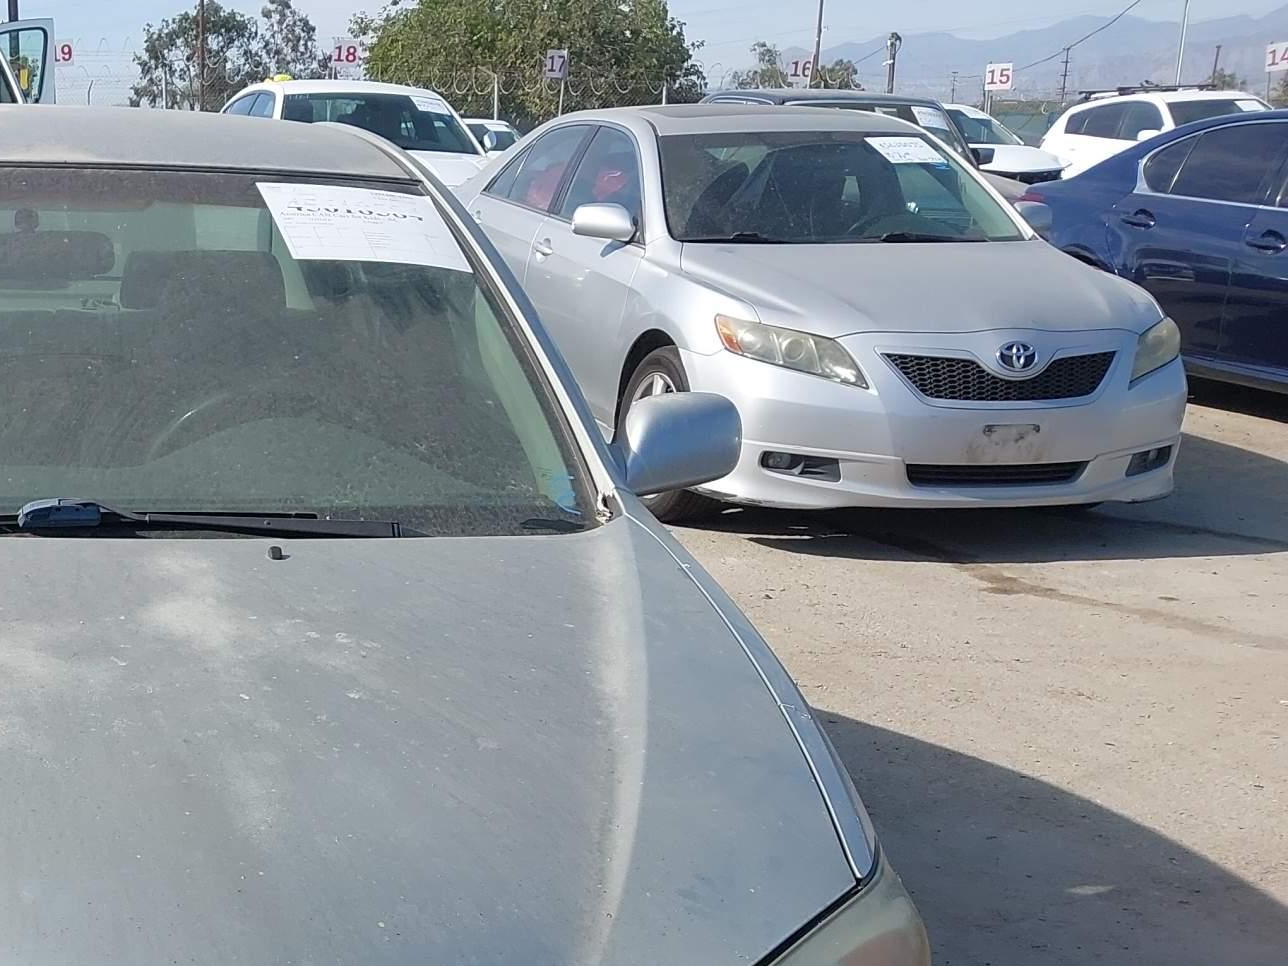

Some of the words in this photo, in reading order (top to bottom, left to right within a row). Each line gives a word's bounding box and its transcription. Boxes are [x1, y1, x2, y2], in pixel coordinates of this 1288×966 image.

[334, 45, 357, 63] 18
[548, 55, 565, 72] 17
[790, 60, 811, 77] 16
[986, 68, 1011, 85] 15
